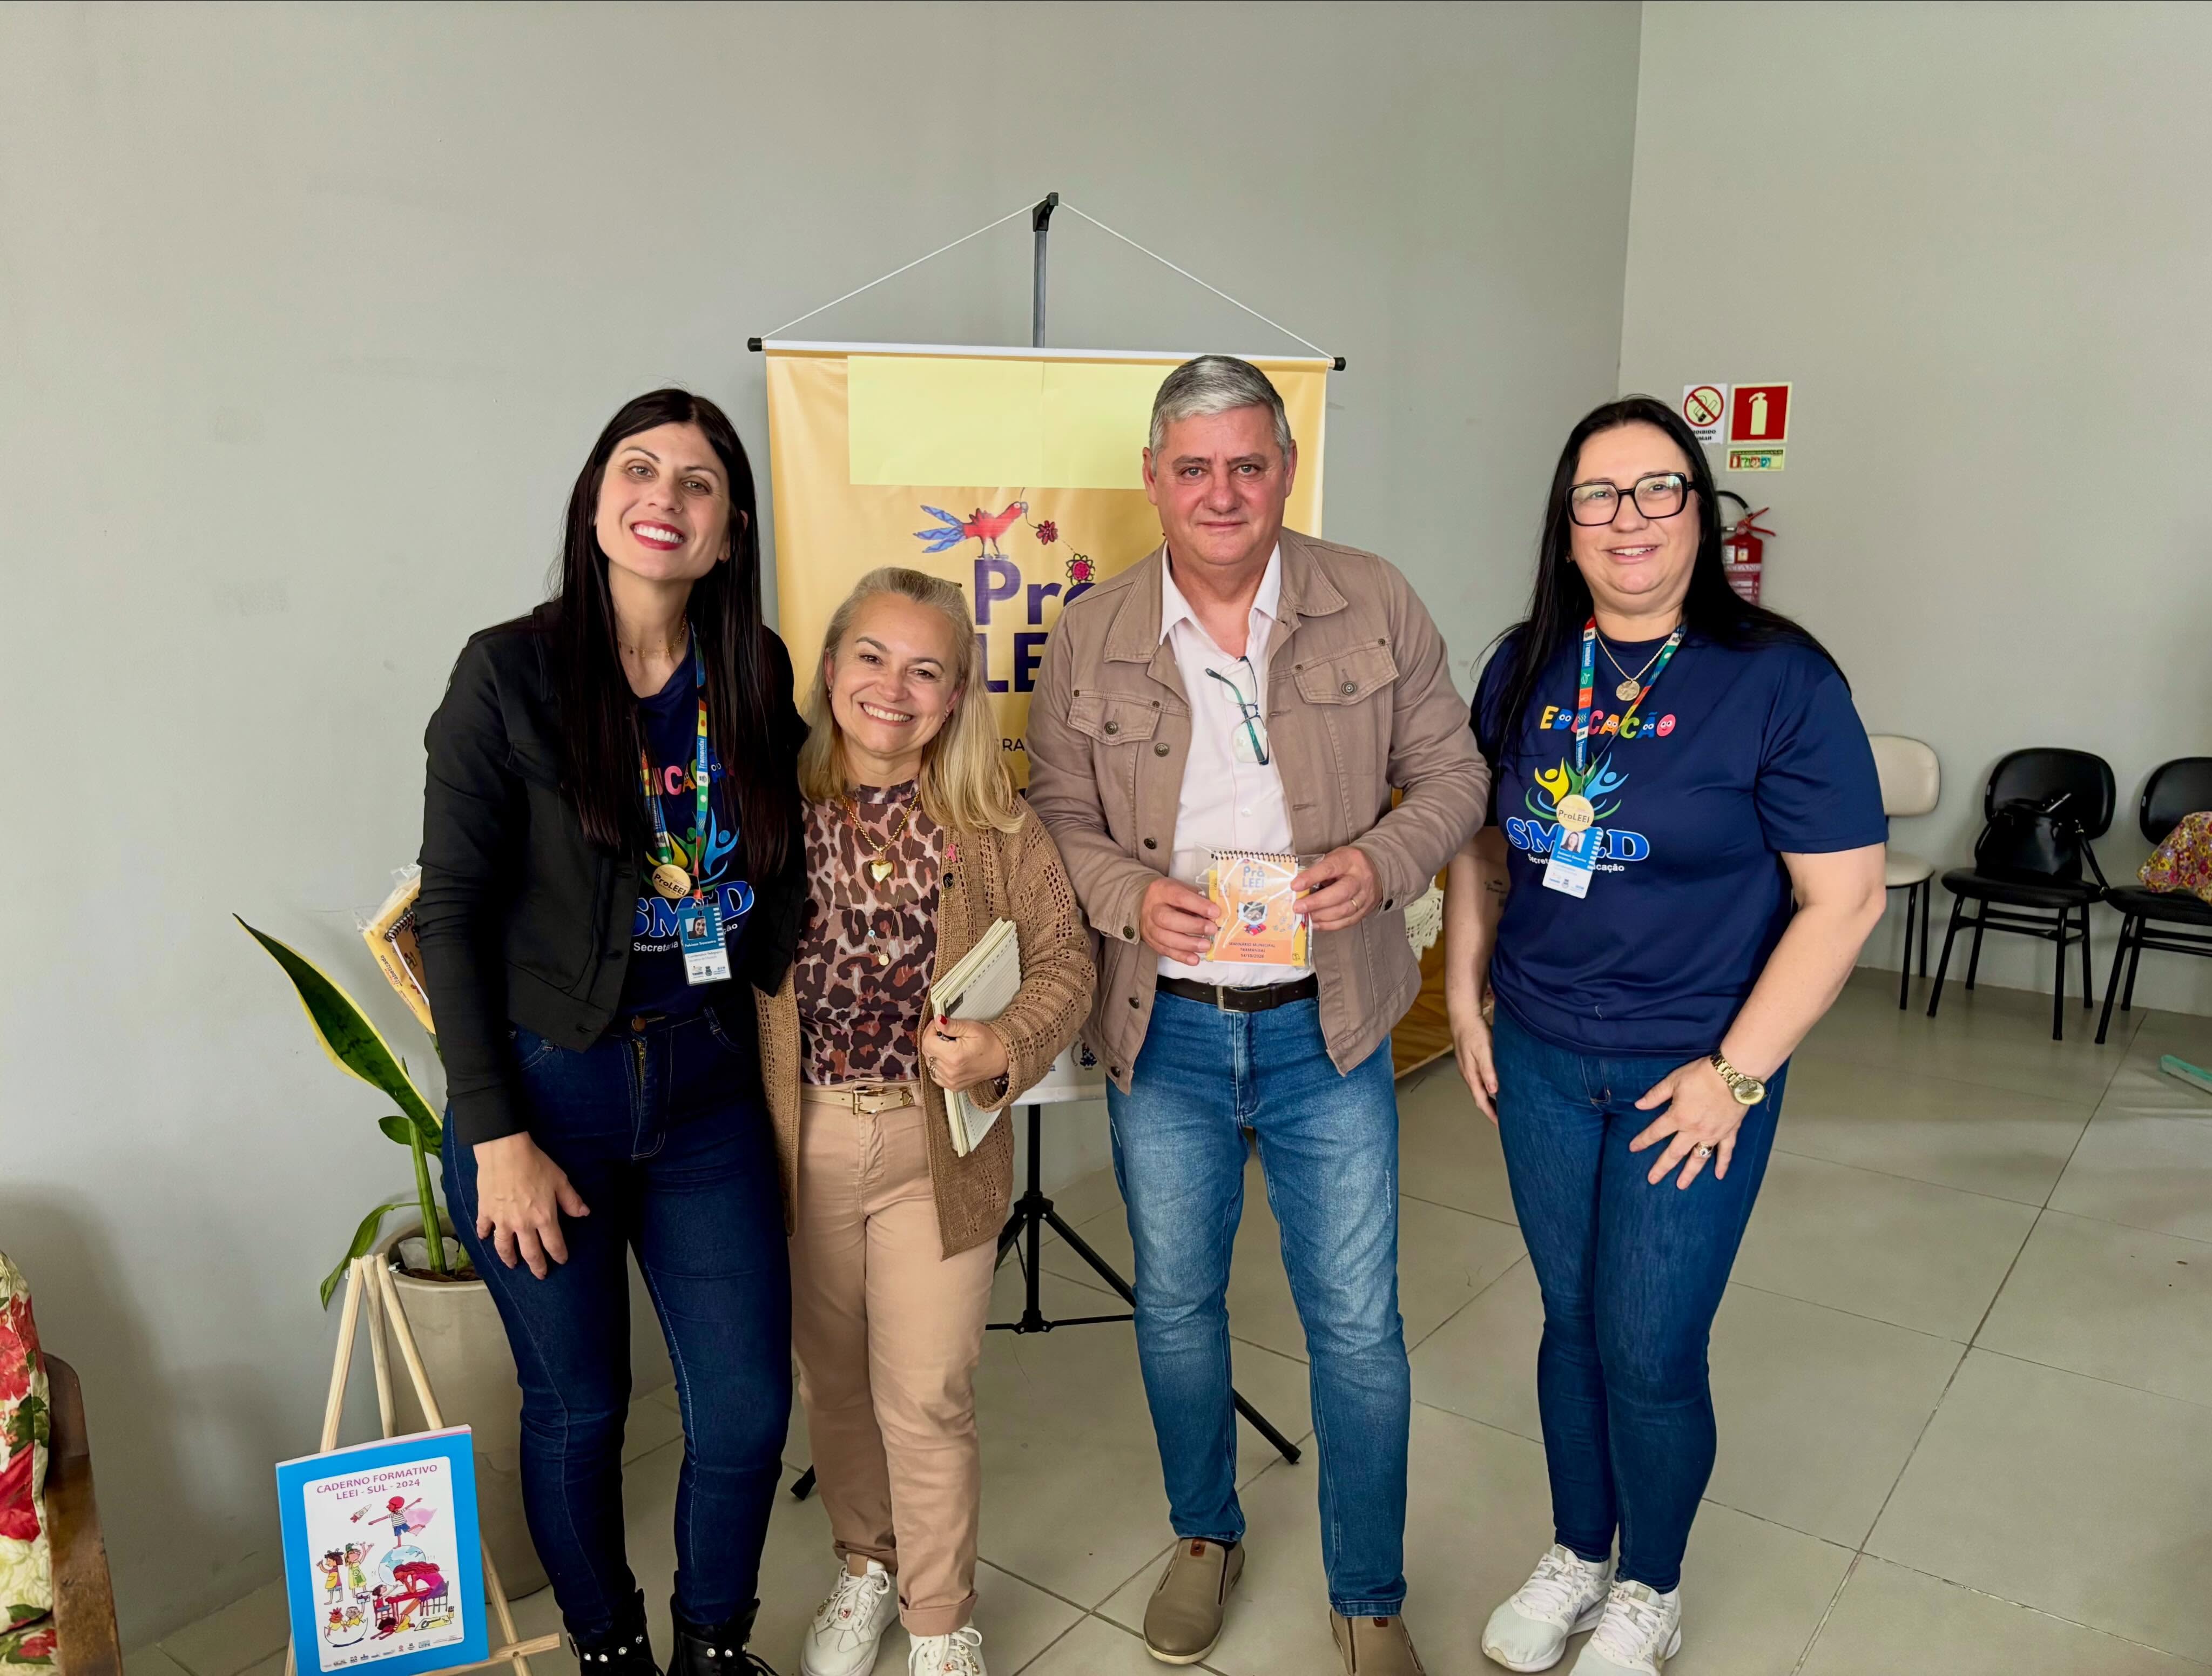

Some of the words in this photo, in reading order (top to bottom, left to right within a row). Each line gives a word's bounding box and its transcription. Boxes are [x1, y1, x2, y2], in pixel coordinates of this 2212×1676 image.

[974, 559, 1096, 625] Pr
[975, 632, 1049, 692] LE
[1558, 810, 1590, 824] ProLEEI
[1506, 817, 1650, 861] SMD
[1527, 853, 1549, 865] Secret
[653, 873, 687, 896] ProLEEI
[316, 1477, 370, 1493] CADERNO
[373, 1464, 437, 1483] FORMATIVO
[336, 1489, 358, 1500] LEEI
[367, 1484, 388, 1494] SUL
[396, 1478, 420, 1489] 2024
